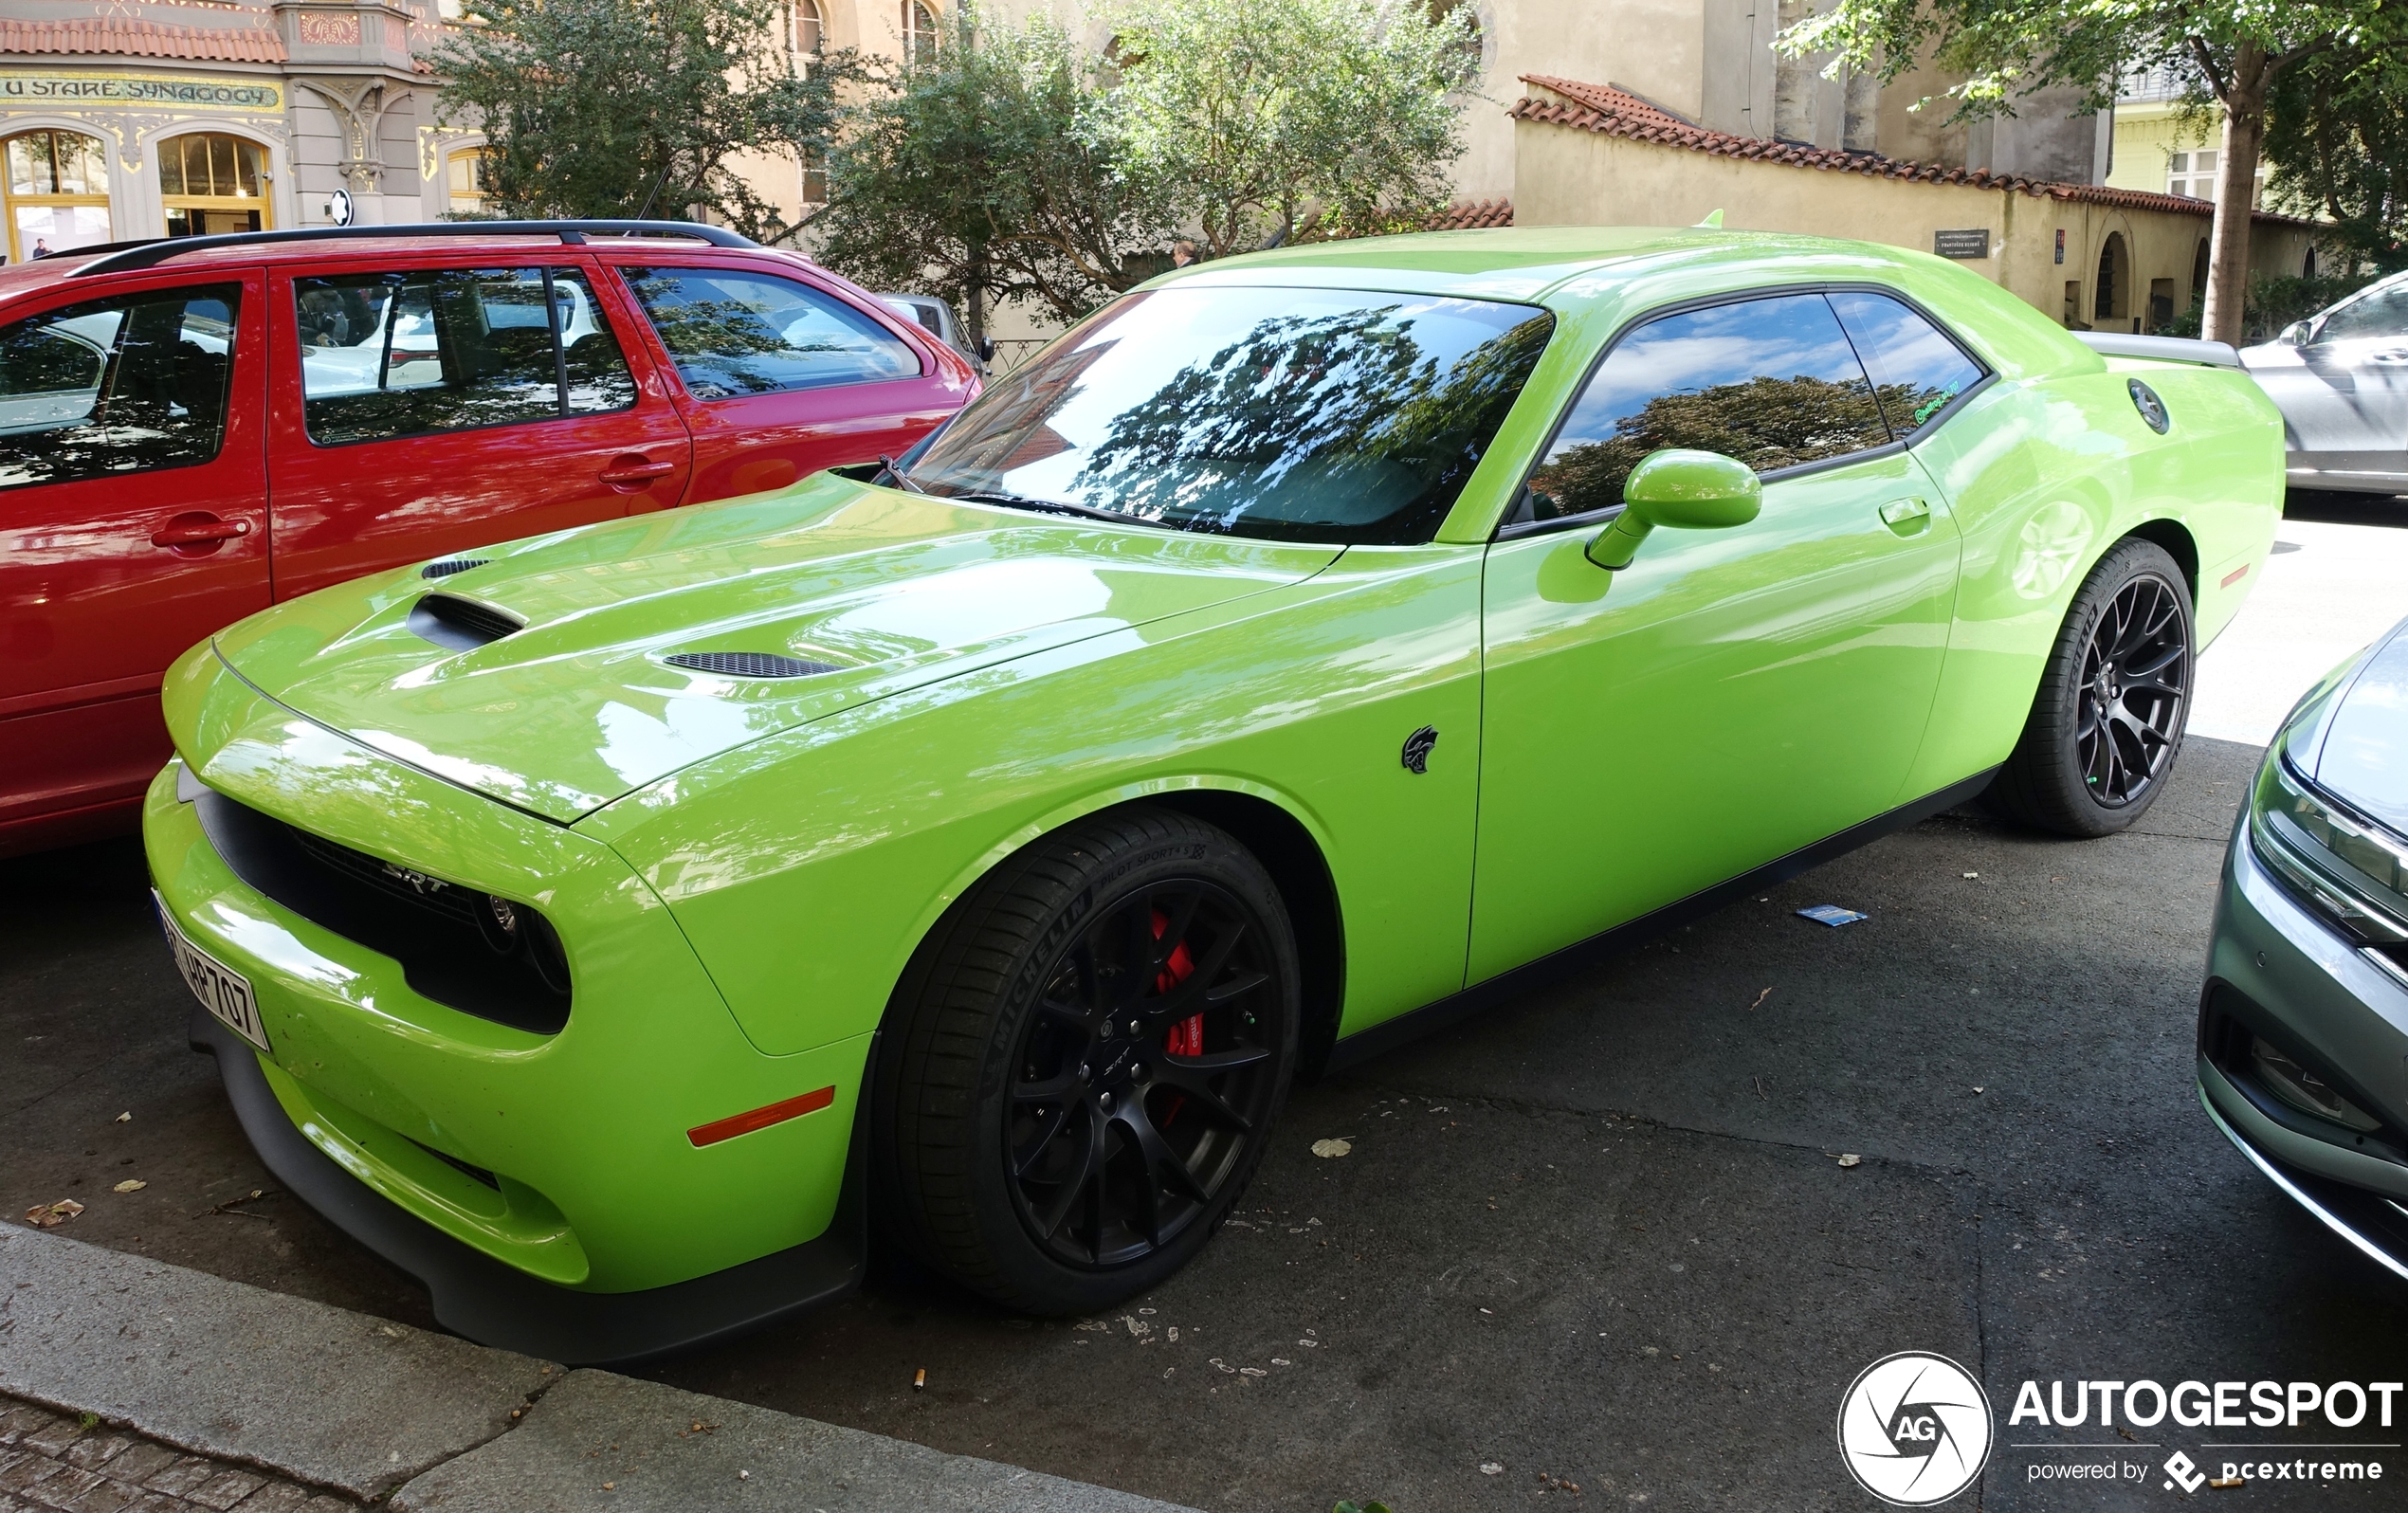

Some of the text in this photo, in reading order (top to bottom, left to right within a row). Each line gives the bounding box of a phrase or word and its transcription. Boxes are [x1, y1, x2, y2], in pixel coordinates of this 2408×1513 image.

[6, 81, 264, 103] U STARÉ SYNAGOGY
[2066, 611, 2096, 709] MICHELIN
[382, 863, 449, 894] SRT
[1101, 861, 1133, 888] PILOT
[1138, 847, 1176, 866] SPORT
[994, 893, 1087, 1051] MICHELIN
[1190, 1016, 1199, 1048] embo
[1104, 1046, 1131, 1076] SRT
